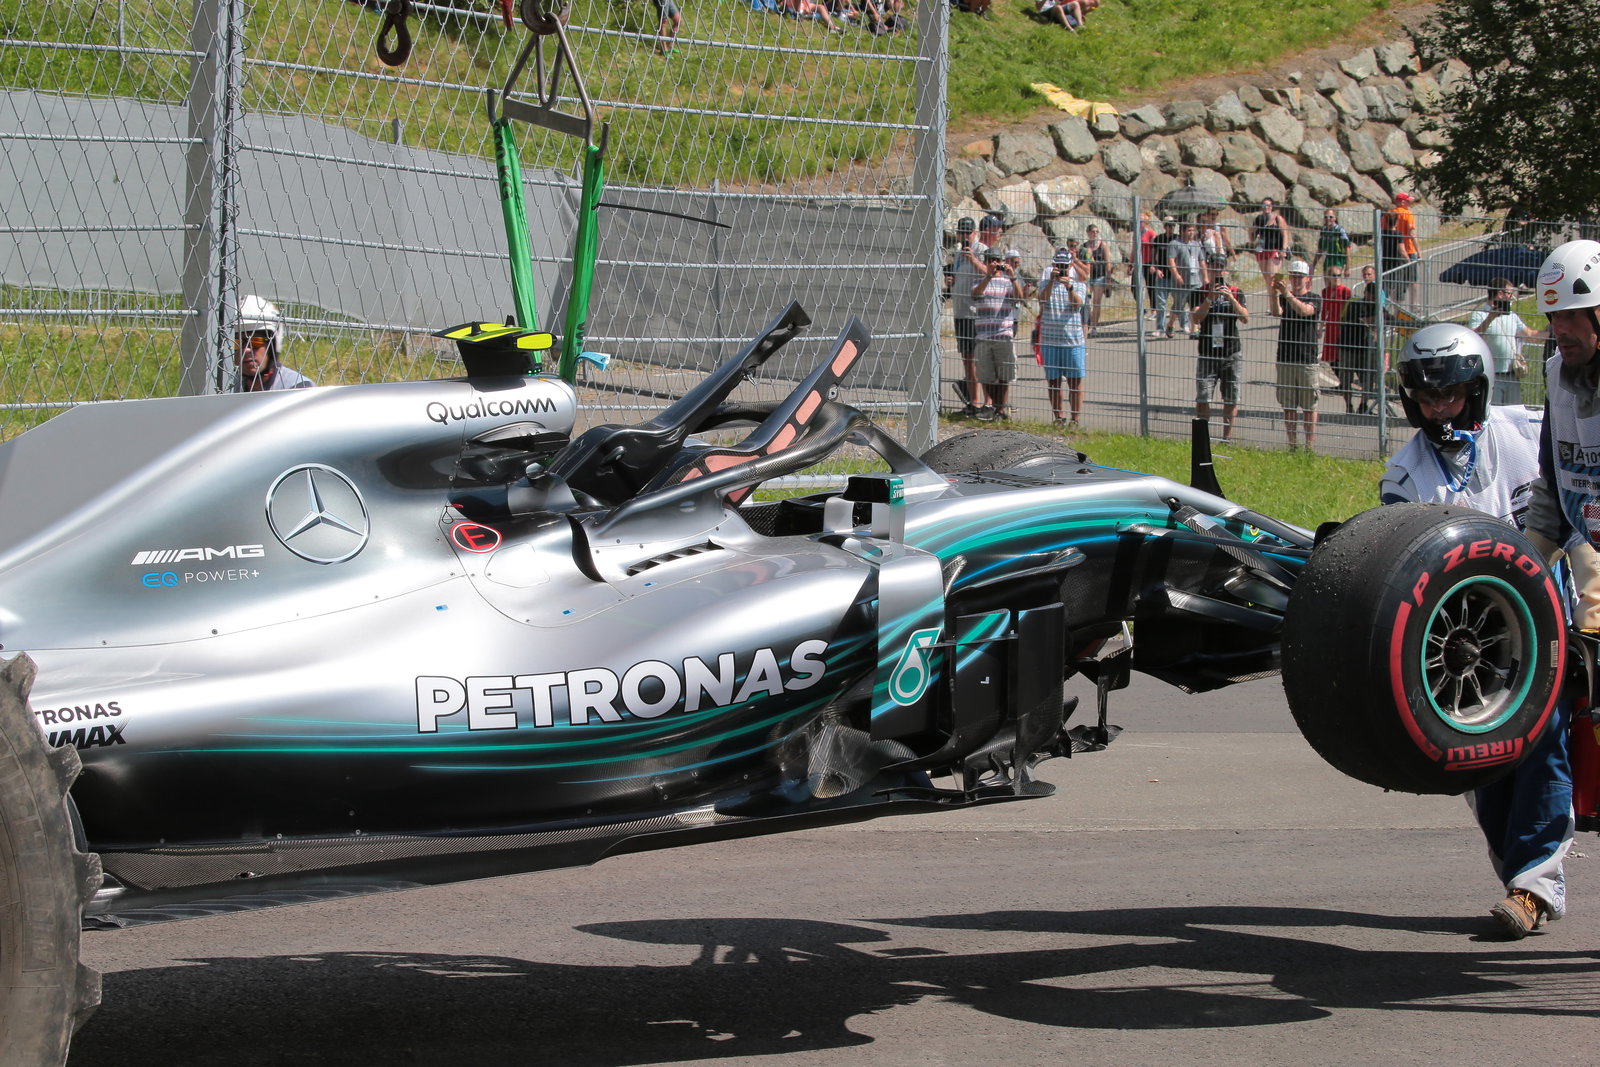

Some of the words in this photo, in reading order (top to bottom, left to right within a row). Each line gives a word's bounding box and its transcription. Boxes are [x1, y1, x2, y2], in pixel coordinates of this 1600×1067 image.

[426, 396, 557, 425] Qualcomm
[459, 525, 494, 550] E
[179, 544, 265, 562] AMG
[142, 572, 179, 588] EQ
[185, 569, 260, 584] POWER+
[1413, 571, 1430, 607] P
[1443, 539, 1541, 577] ZERO
[417, 639, 828, 734] PETRONAS
[1444, 737, 1524, 770] PIRELLI
